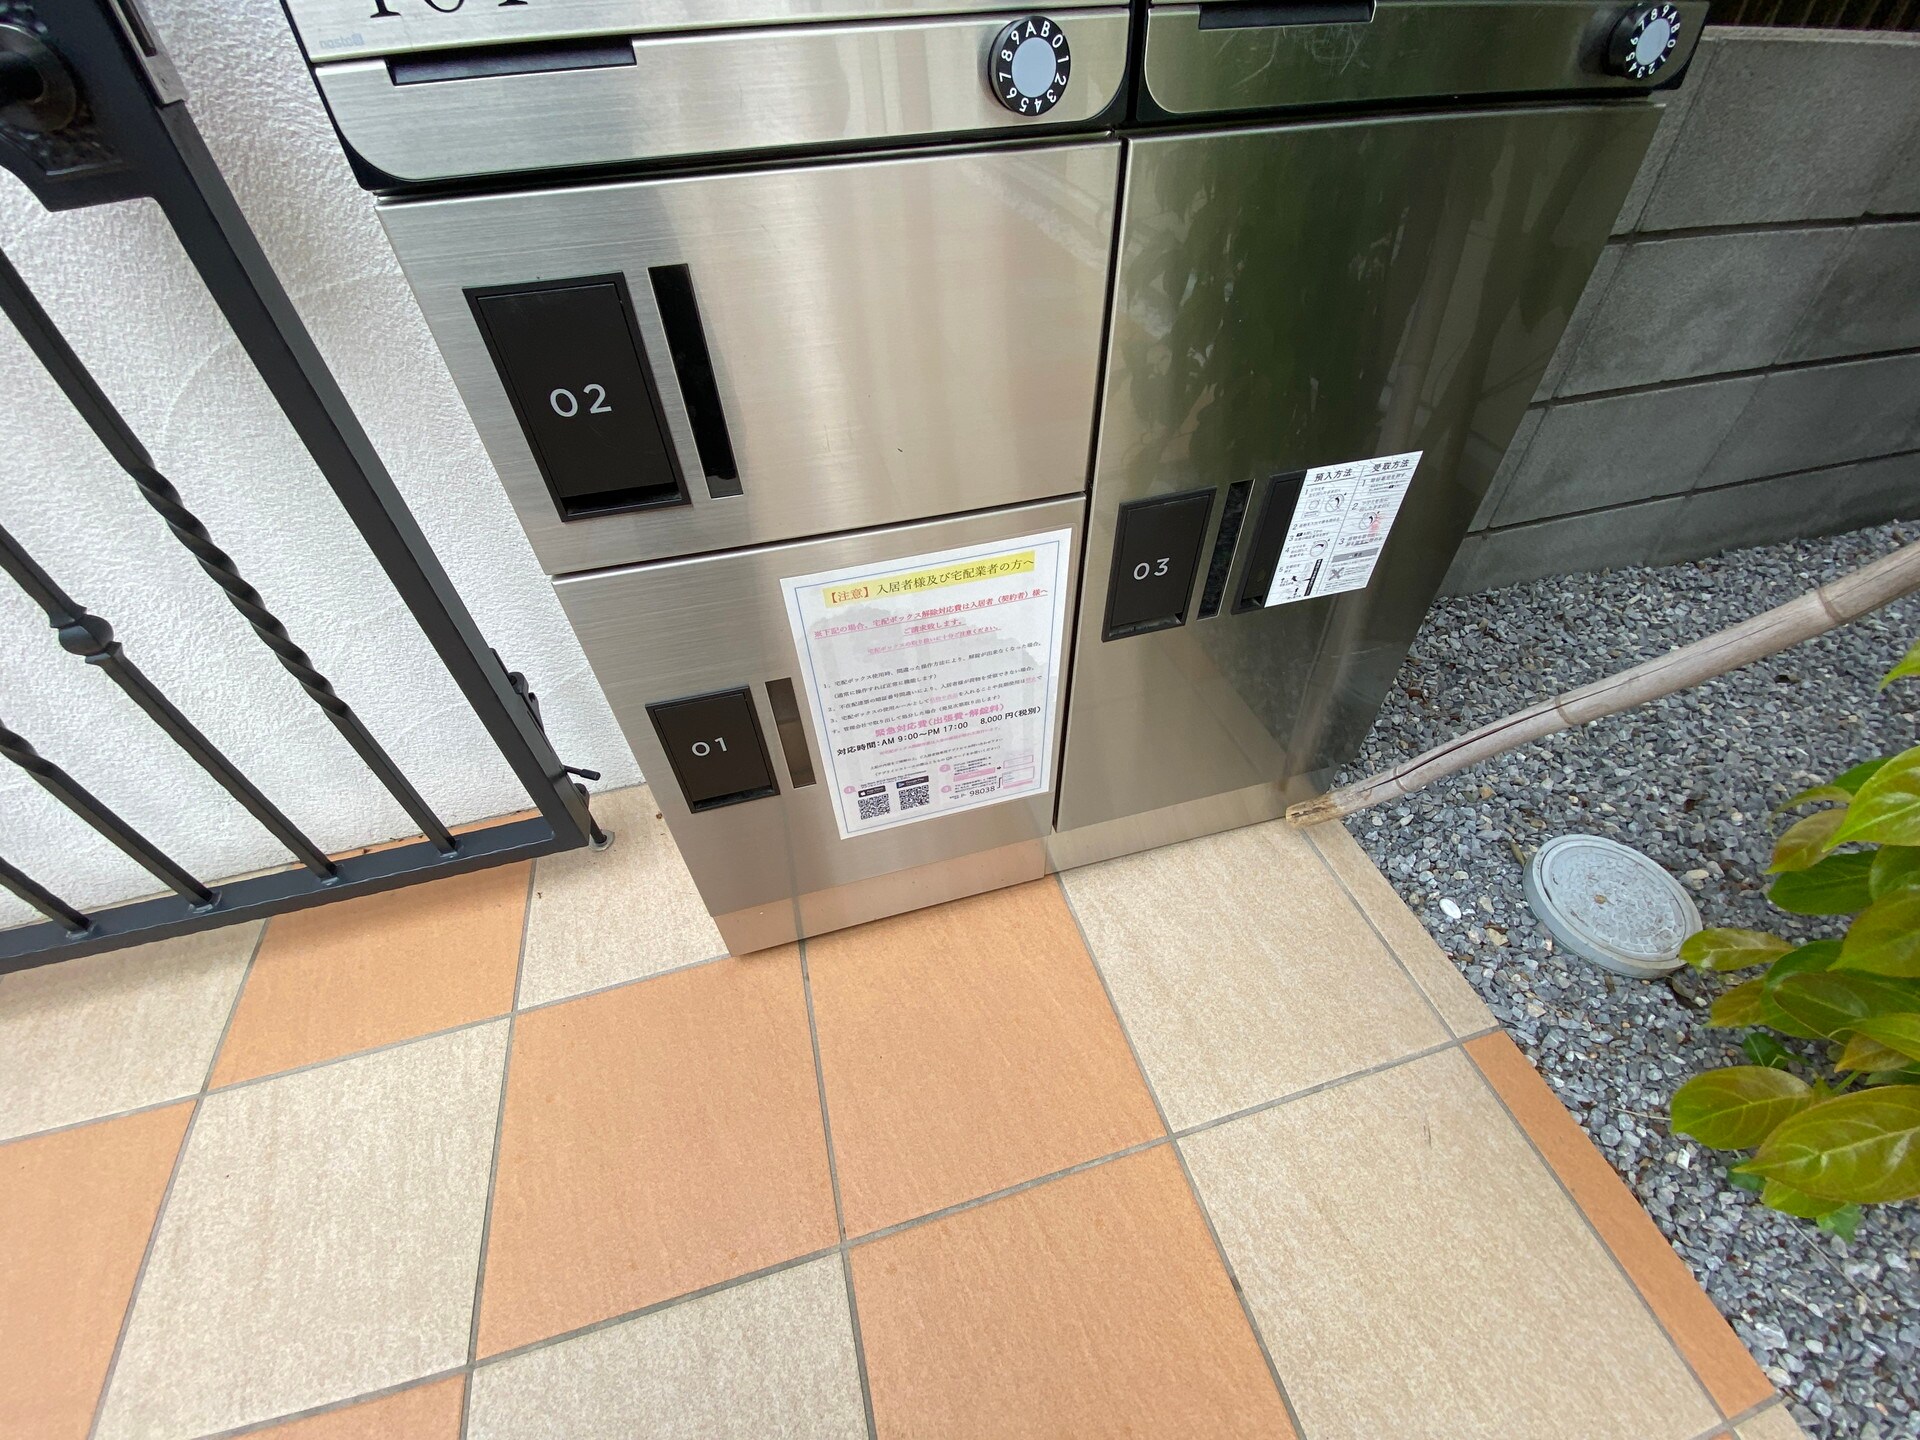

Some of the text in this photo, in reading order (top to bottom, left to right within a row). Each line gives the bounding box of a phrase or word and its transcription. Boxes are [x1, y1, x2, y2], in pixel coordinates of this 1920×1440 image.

[550, 383, 612, 417] 02
[1372, 460, 1410, 472] 受取方法
[1314, 468, 1352, 482] 預入方法
[1134, 558, 1170, 580] 03
[692, 737, 727, 757] 01
[969, 786, 996, 797] 98038
